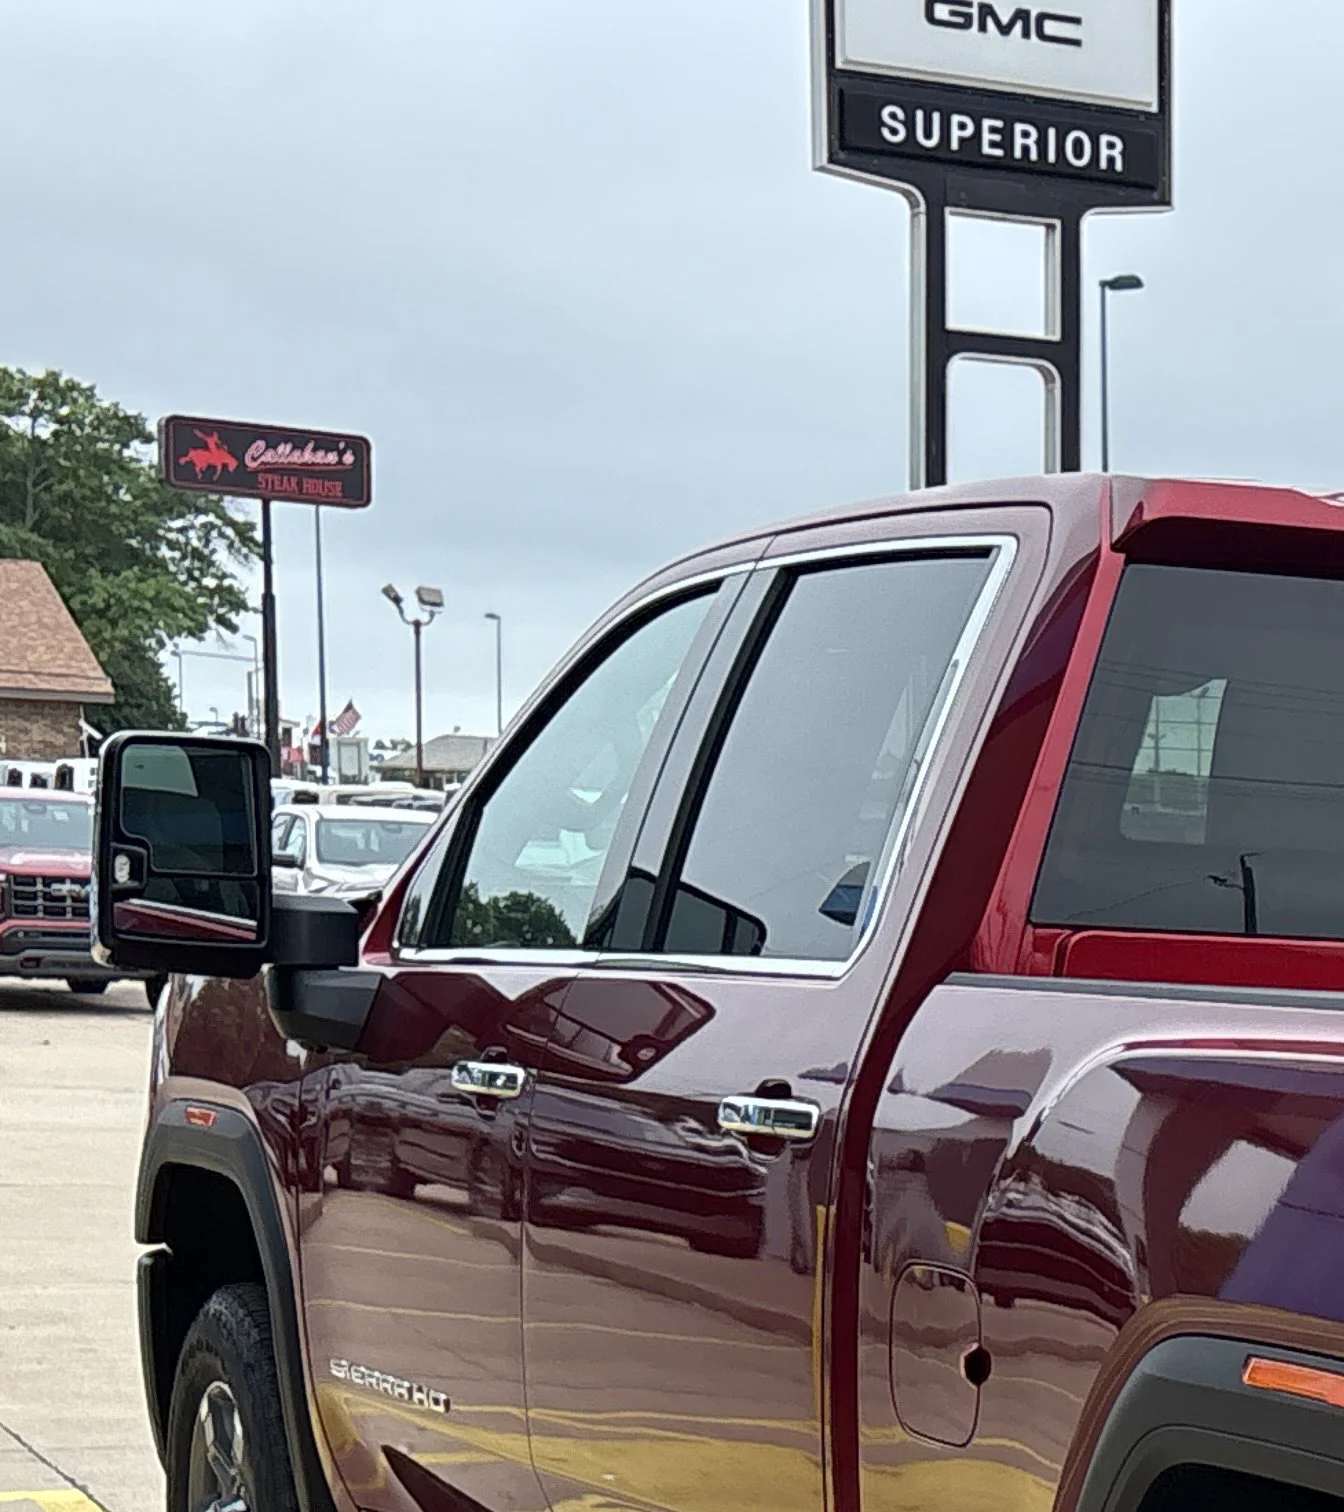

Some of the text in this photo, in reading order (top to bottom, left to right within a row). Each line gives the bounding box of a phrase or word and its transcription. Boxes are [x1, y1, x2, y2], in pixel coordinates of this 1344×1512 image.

[924, 0, 1083, 48] GMC
[880, 104, 1125, 174] SUPERIOR
[244, 439, 355, 469] Callahan's
[257, 472, 343, 497] STEAK HOUSE
[329, 1357, 450, 1414] SIERRA HD
